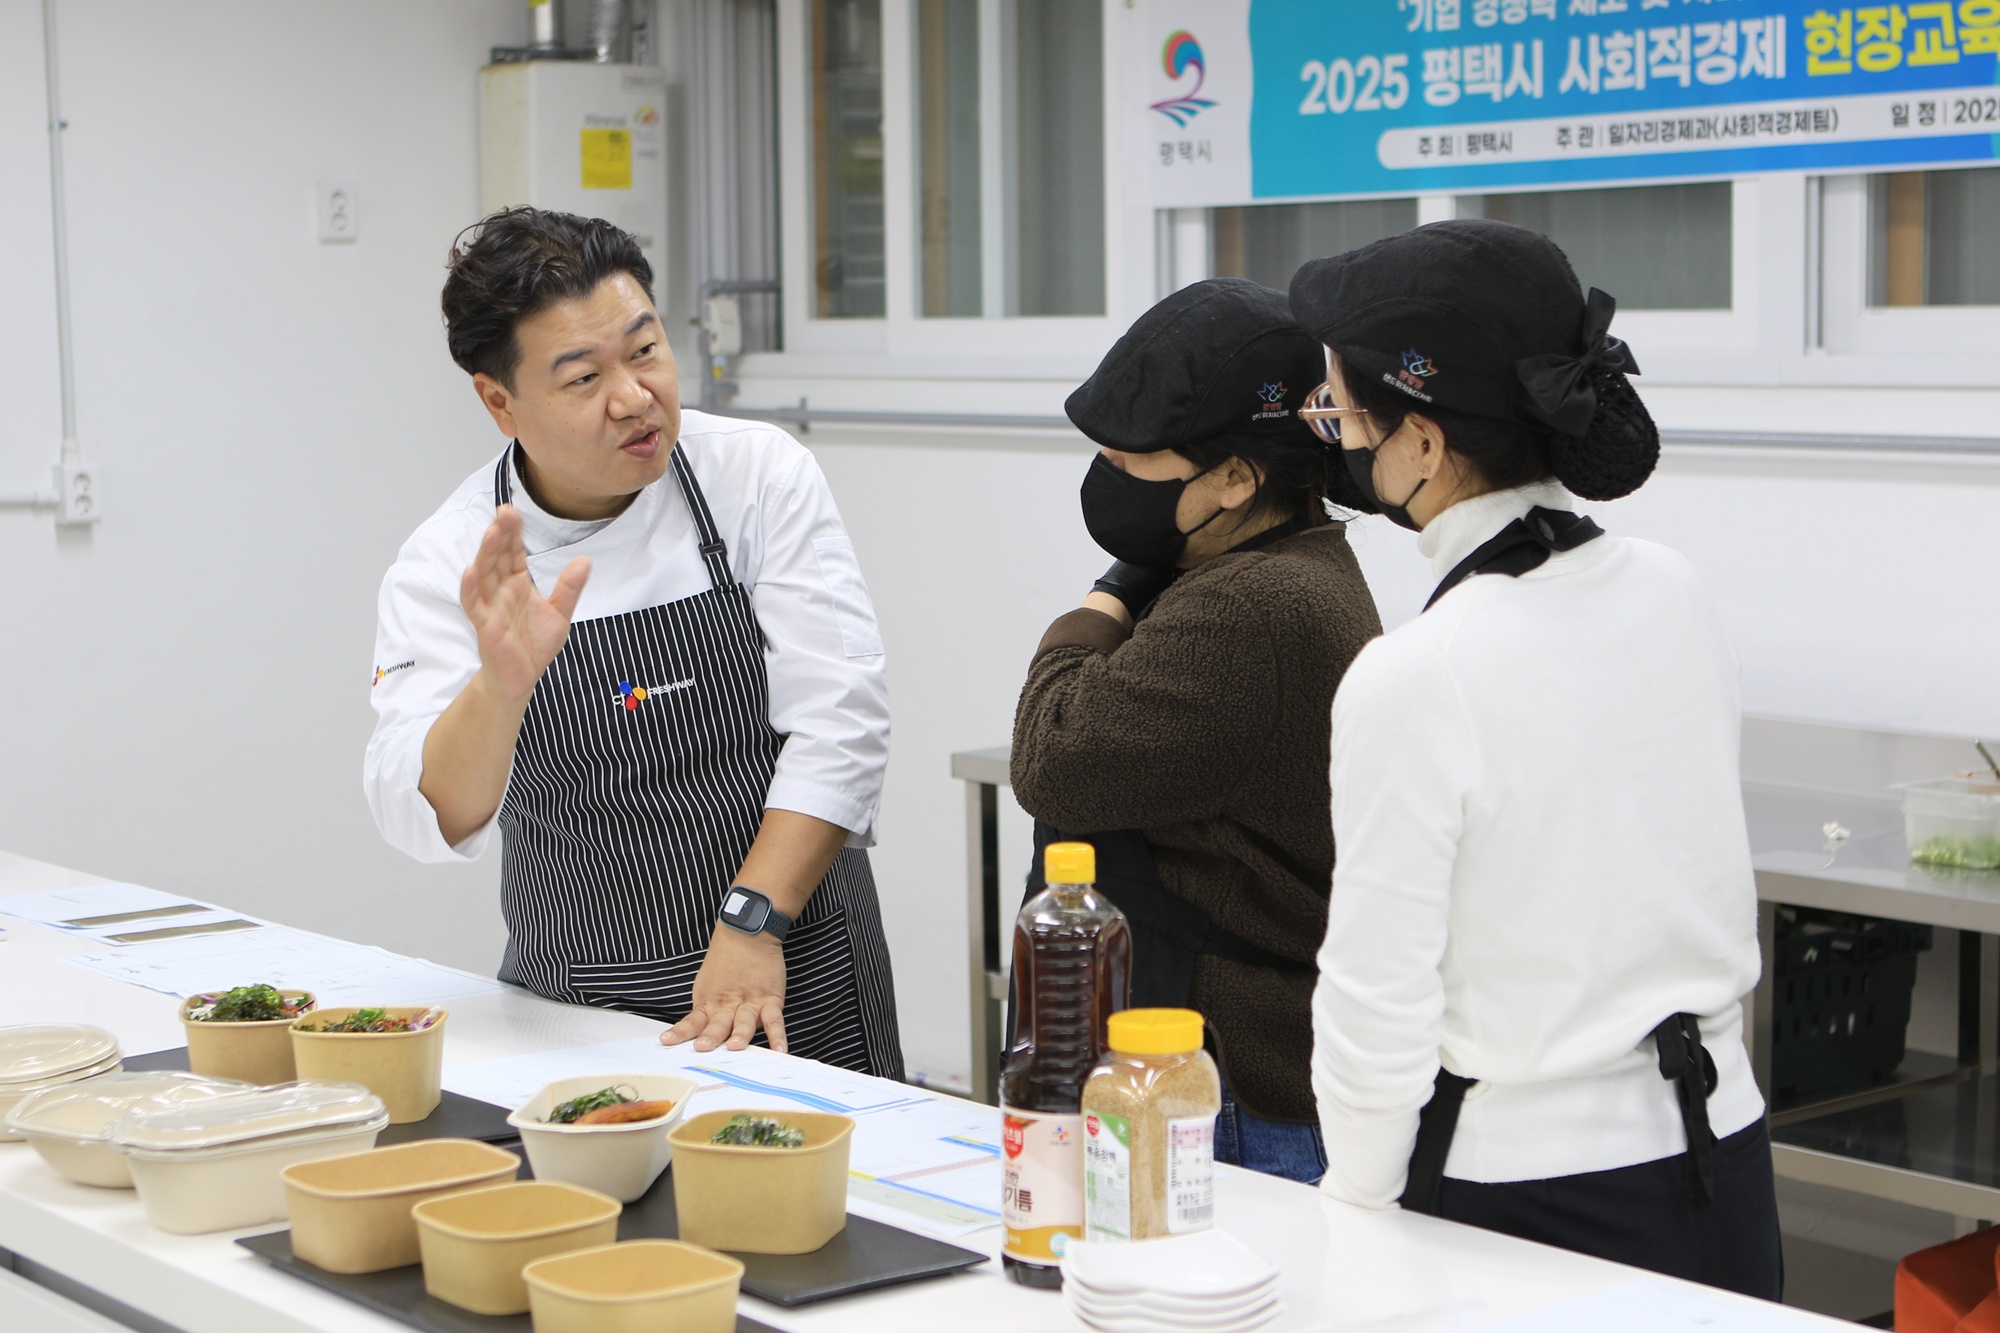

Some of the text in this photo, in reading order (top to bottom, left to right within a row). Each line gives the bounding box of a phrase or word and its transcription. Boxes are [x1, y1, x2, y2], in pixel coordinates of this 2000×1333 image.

[1299, 0, 2000, 115] 2025 평택시 사회적경제 현장교육
[1954, 96, 2000, 124] 202
[1608, 106, 1840, 145] 일자리경제과(사회적경제팀)
[1159, 140, 1212, 167] 평택시
[1466, 131, 1513, 155] 평택시
[611, 677, 695, 707] CJ FRESHWAY
[1003, 1185, 1033, 1213] 기름
